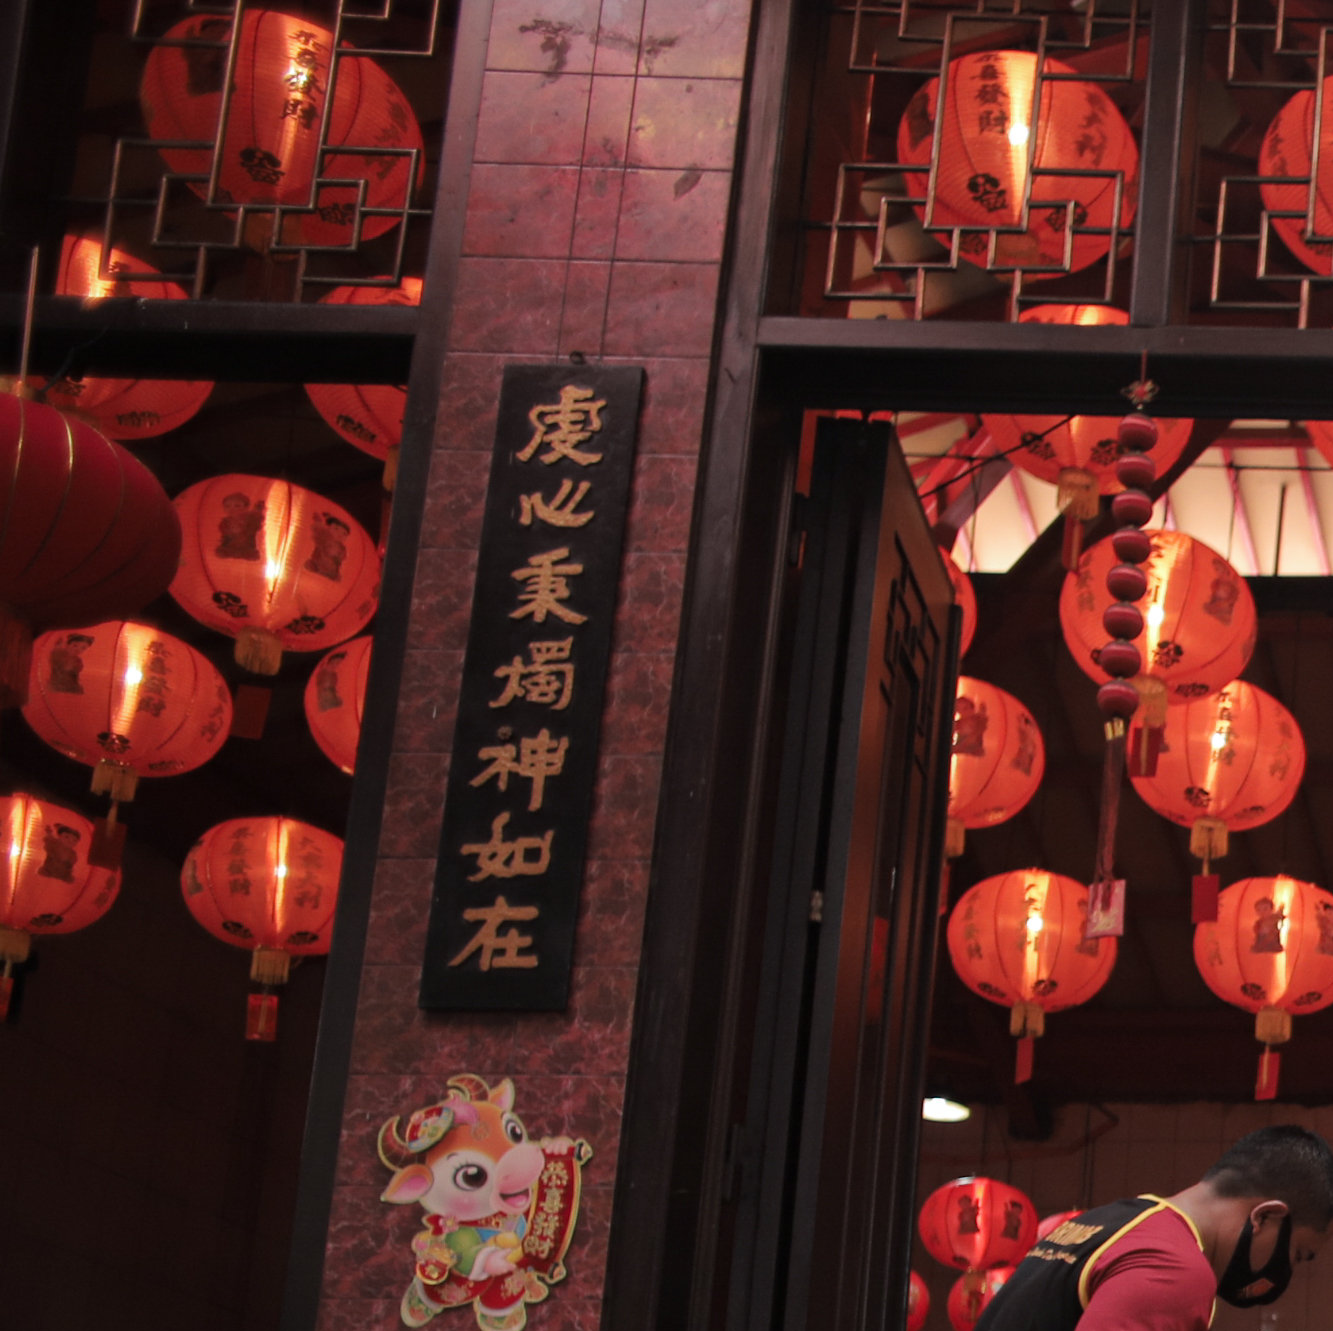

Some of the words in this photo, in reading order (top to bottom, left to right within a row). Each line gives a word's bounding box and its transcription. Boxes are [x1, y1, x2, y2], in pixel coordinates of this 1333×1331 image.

[447, 384, 609, 973] 虔心秉燭神如在
